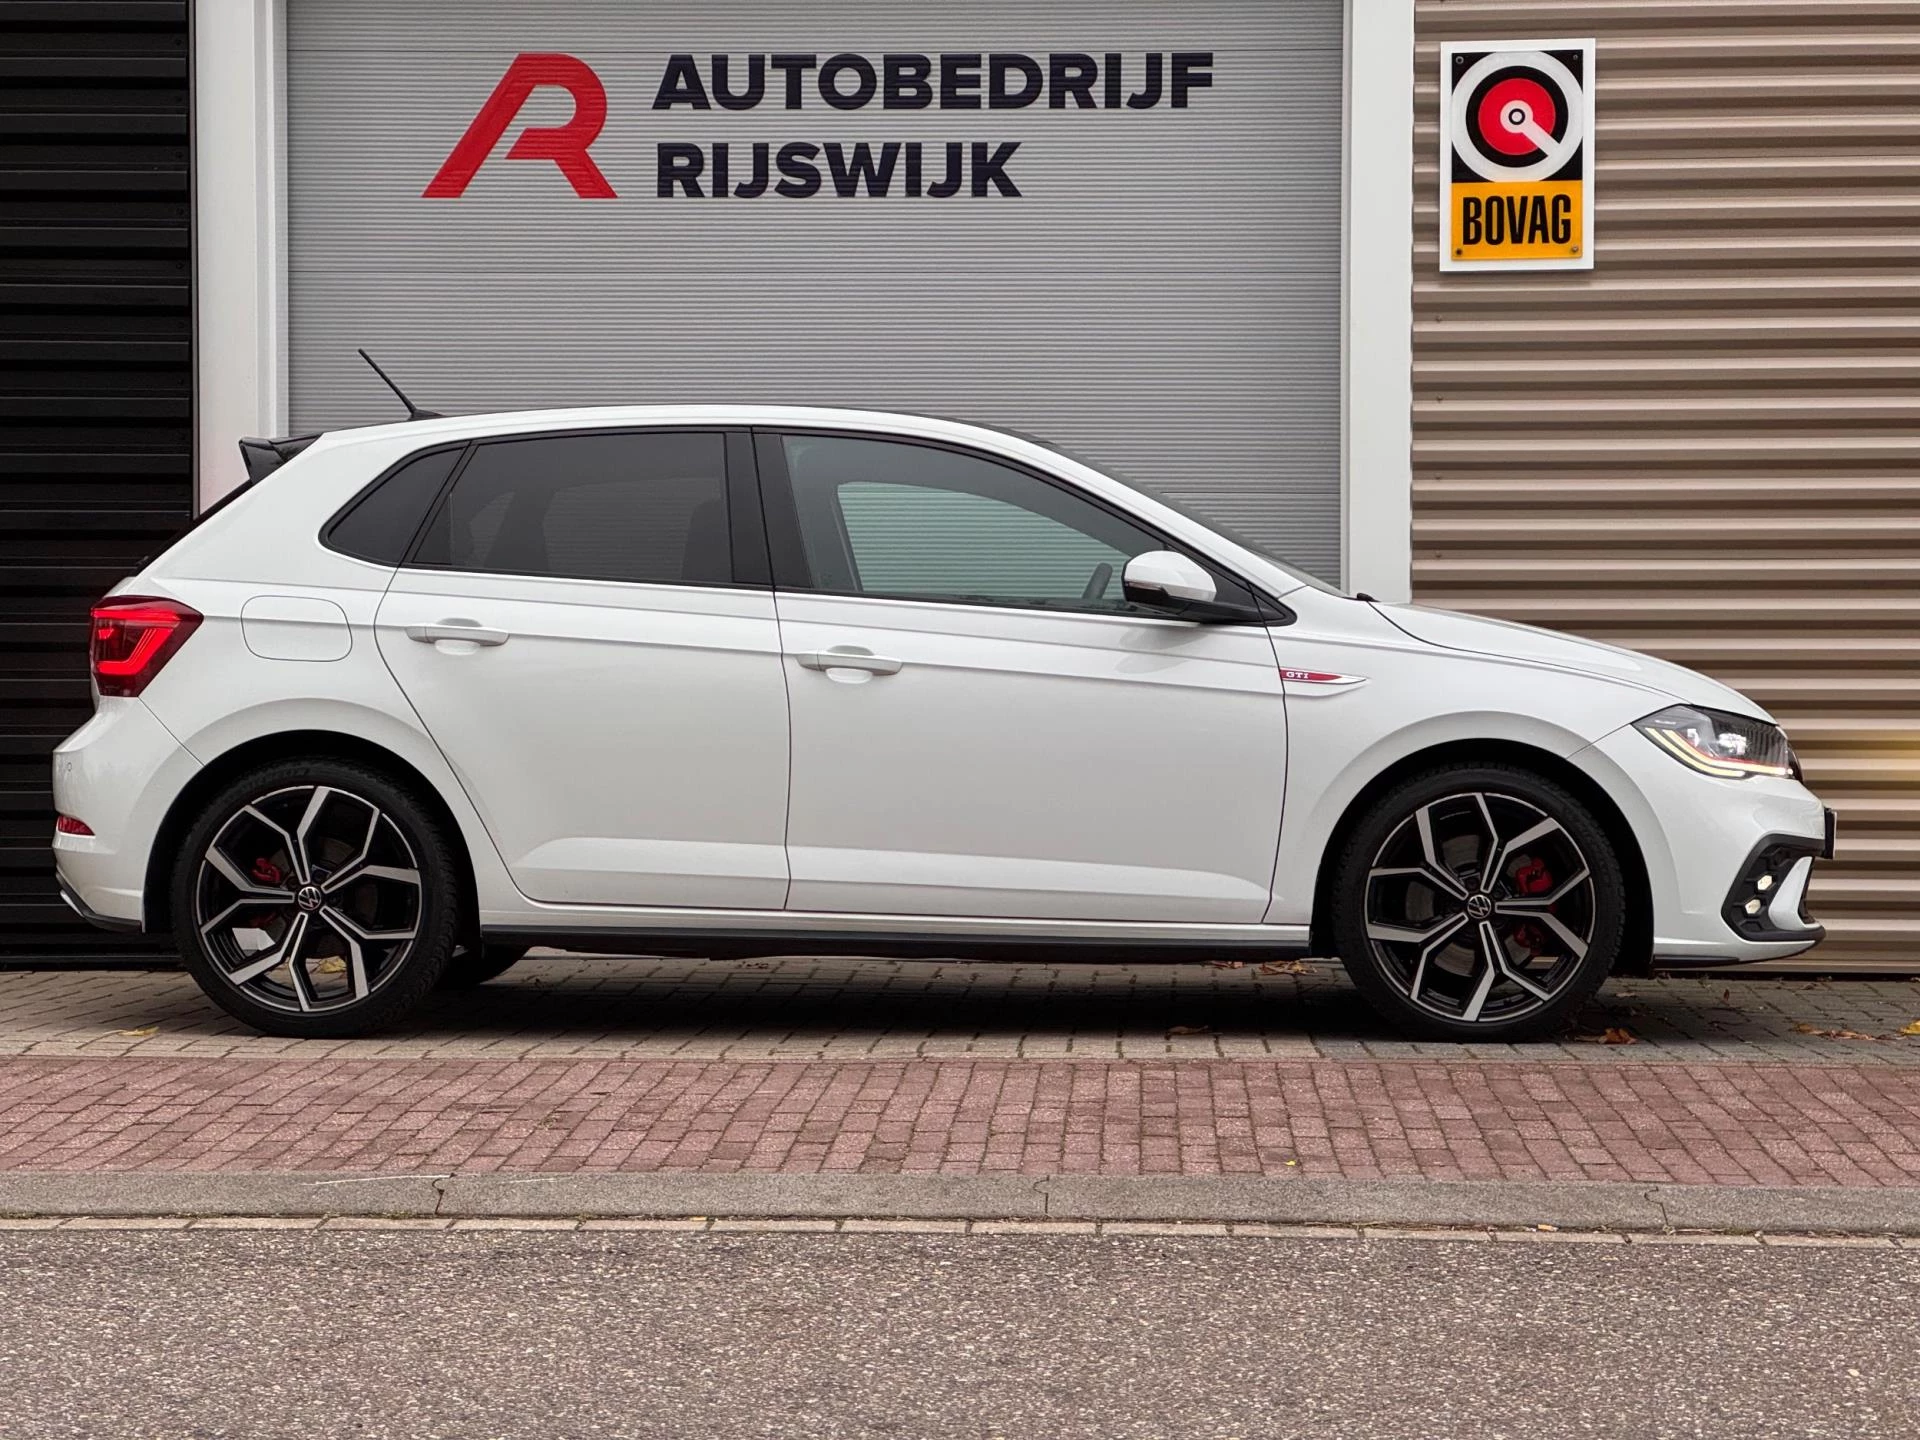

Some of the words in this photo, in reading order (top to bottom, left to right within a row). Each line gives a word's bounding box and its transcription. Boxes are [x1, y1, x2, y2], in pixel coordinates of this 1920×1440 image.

[652, 53, 1213, 110] AUTOBEDRIJF
[657, 142, 1022, 198] RIJSWIJK
[1463, 194, 1571, 246] BOVAG
[1286, 671, 1309, 679] GTI
